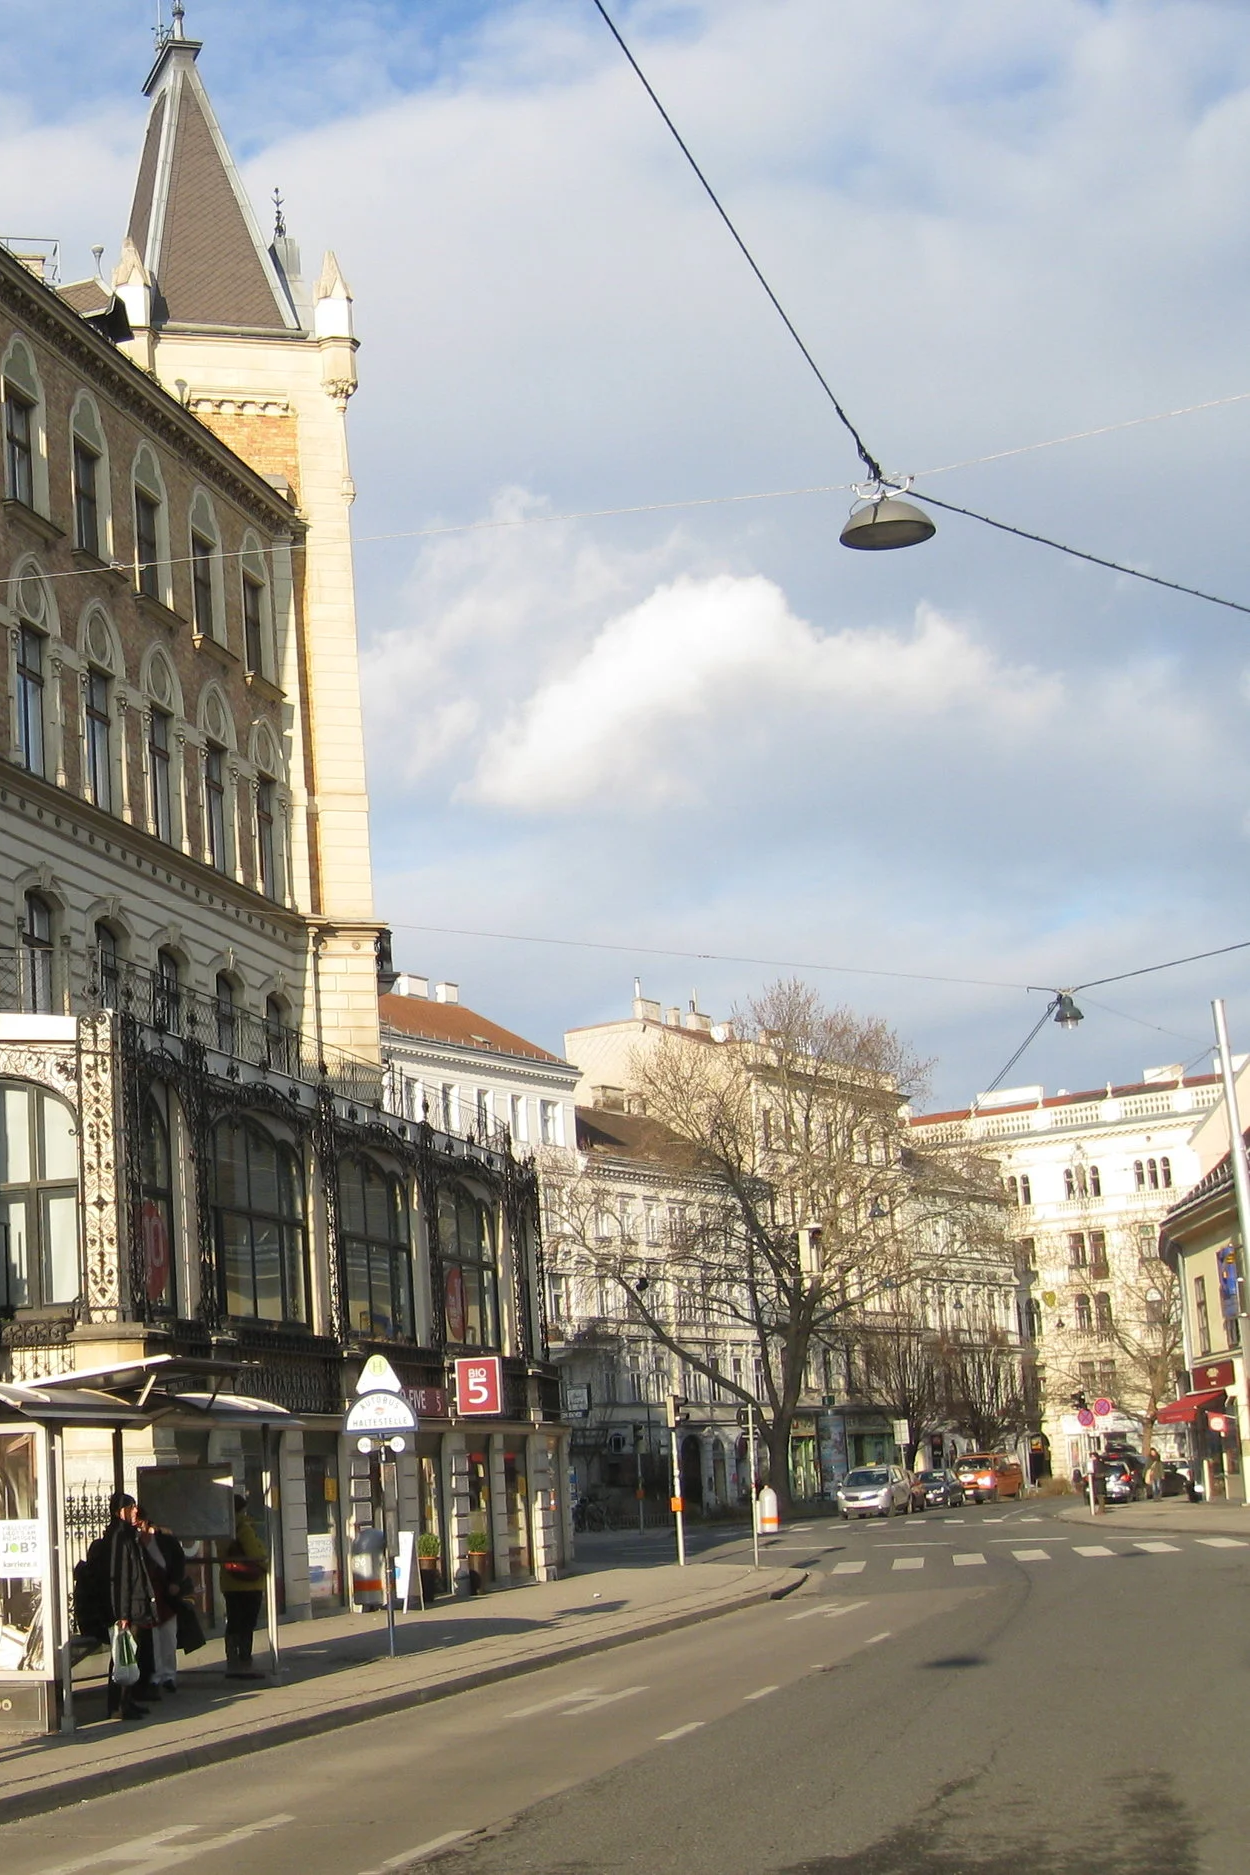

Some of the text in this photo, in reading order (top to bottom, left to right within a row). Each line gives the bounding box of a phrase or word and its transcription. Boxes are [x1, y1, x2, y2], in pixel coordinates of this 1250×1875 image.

[373, 1361, 382, 1372] H
[468, 1368, 486, 1378] BIO
[468, 1377, 489, 1404] 5
[360, 1396, 400, 1411] AUTOBUS
[408, 1389, 427, 1410] FIVE
[352, 1416, 408, 1428] HALTESTELLE
[2, 1542, 38, 1554] JOB?
